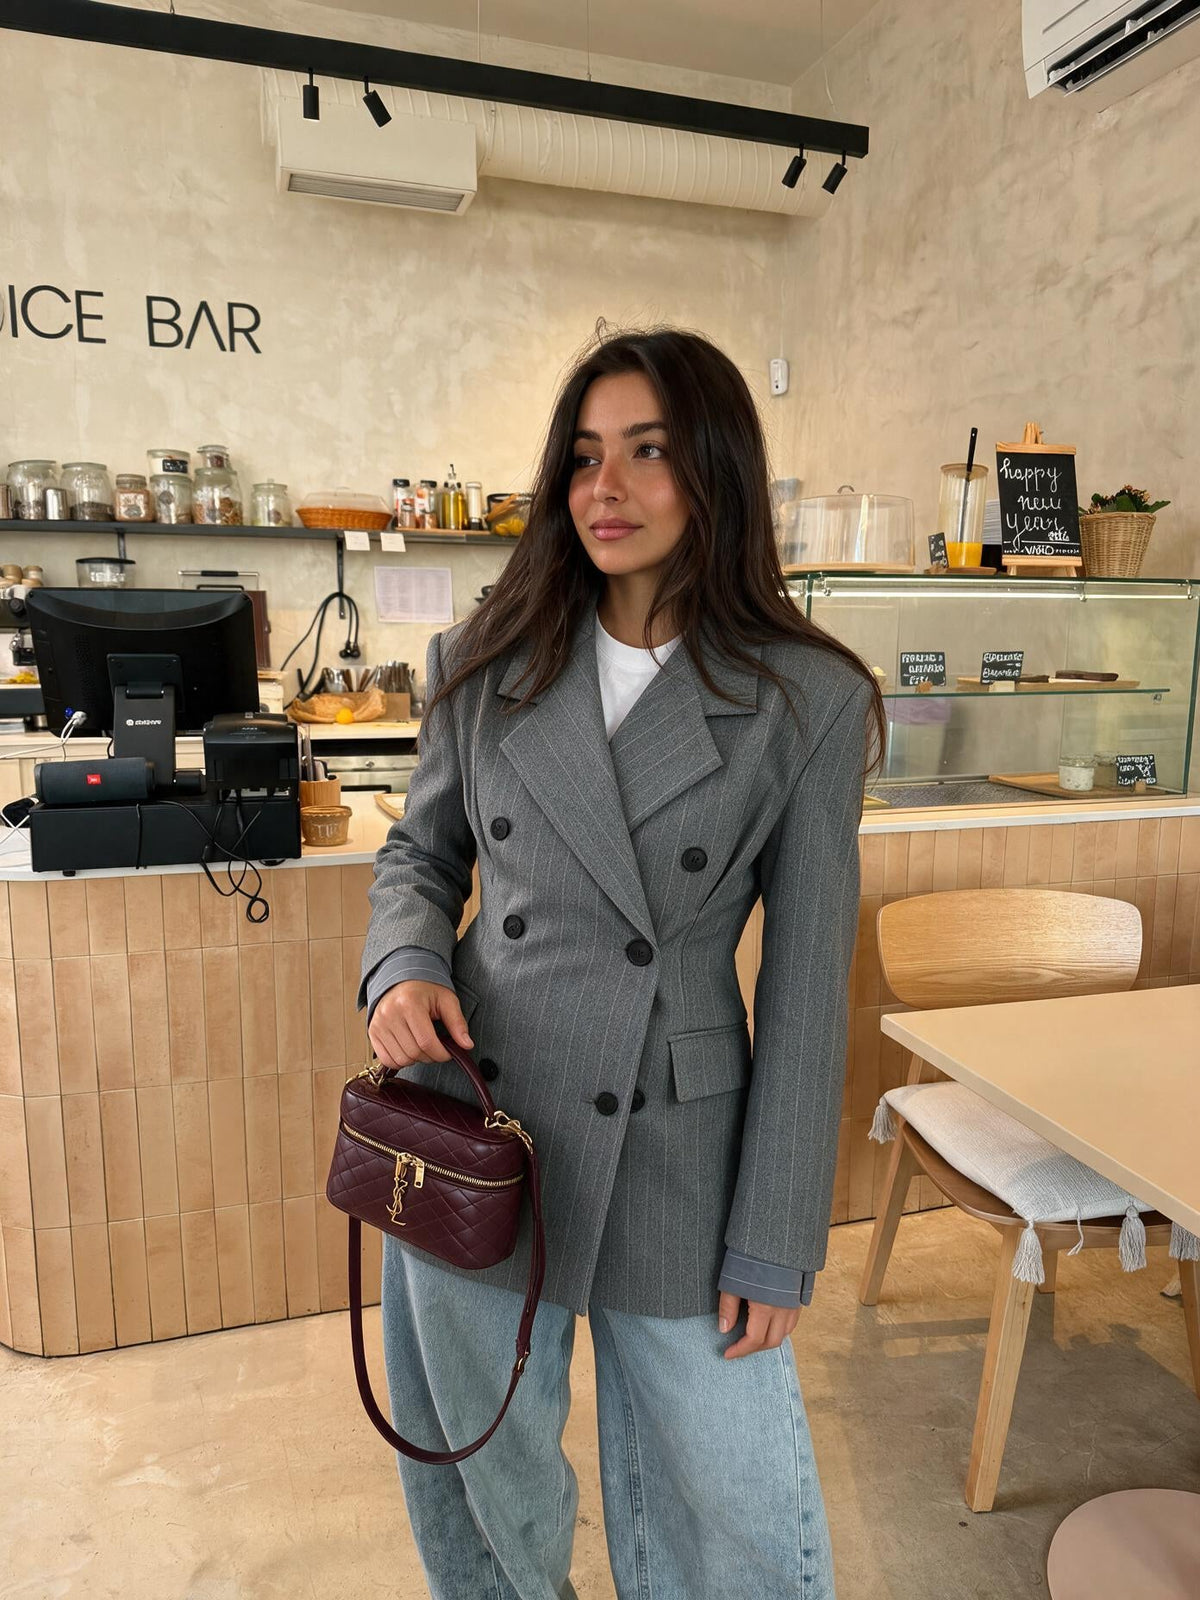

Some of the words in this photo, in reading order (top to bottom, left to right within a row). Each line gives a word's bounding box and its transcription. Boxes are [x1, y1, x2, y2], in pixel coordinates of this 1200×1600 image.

[0, 284, 106, 344] ICE
[146, 295, 262, 354] BAR
[1017, 495, 1061, 511] new
